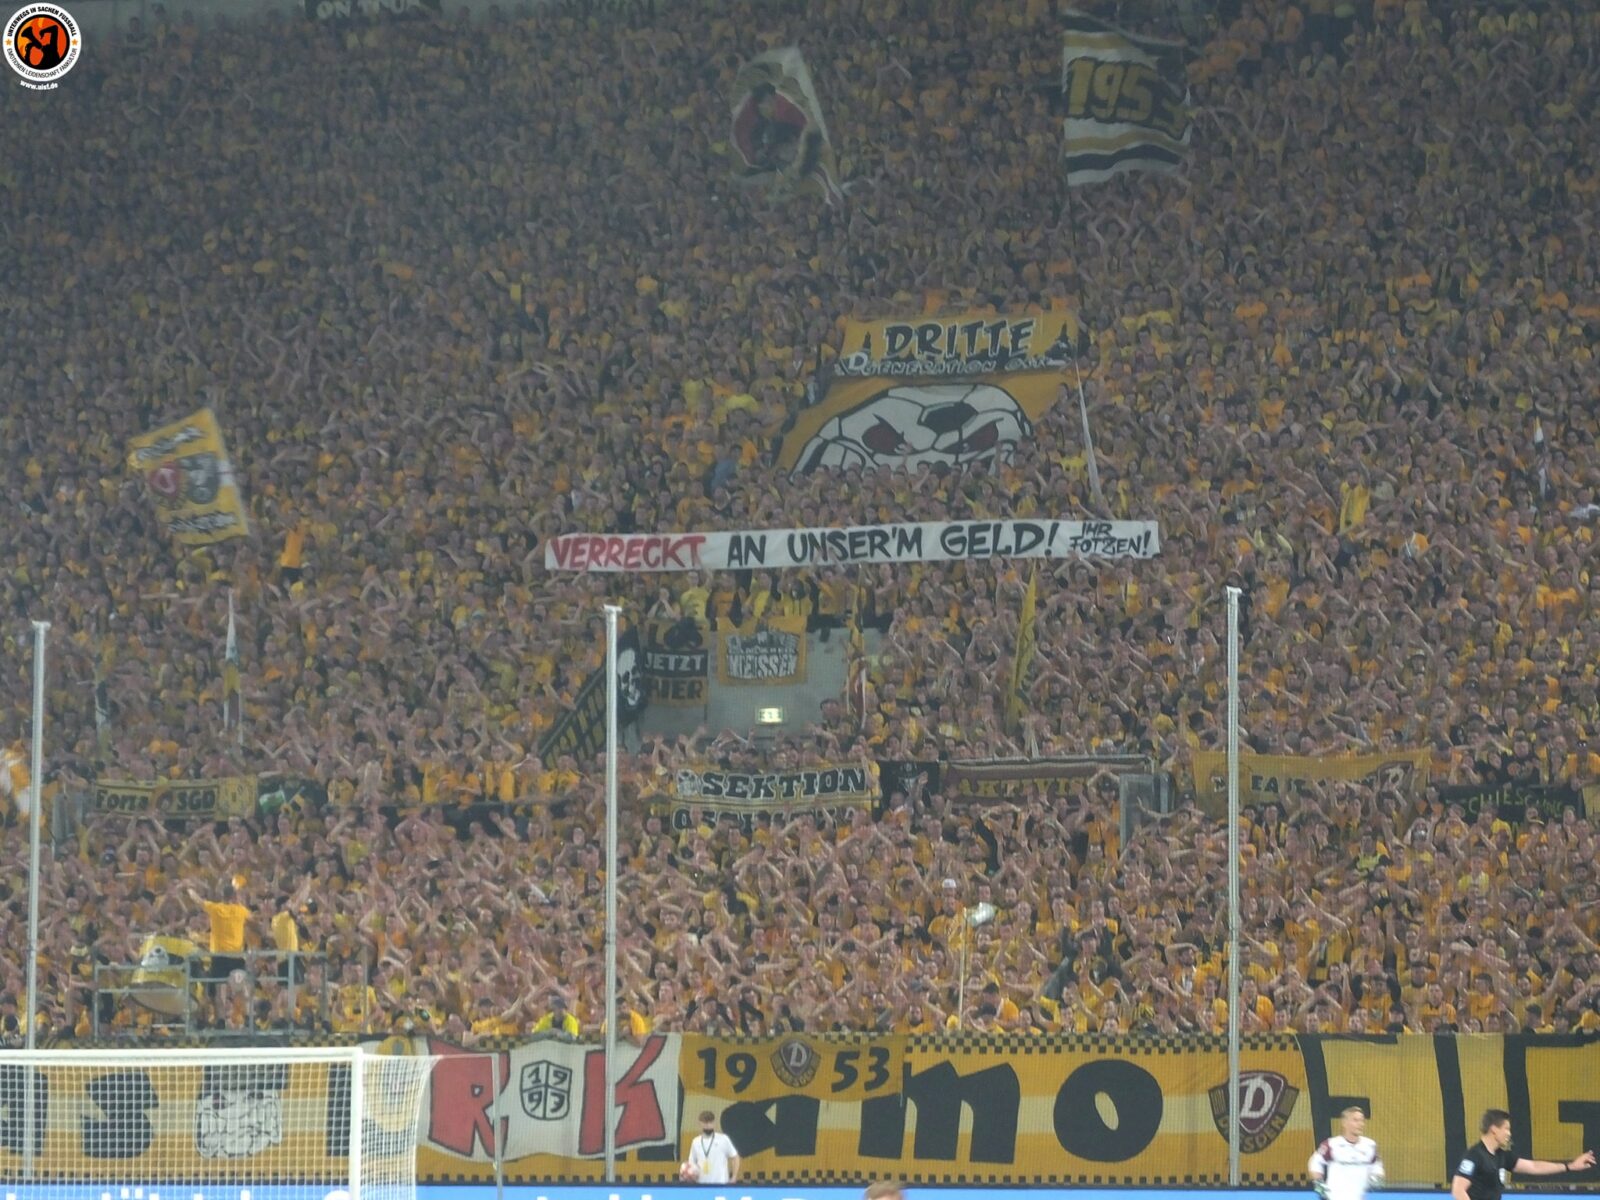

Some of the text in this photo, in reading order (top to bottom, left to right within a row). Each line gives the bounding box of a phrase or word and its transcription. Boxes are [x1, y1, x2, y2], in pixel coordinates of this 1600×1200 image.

[884, 317, 1036, 359] DRITTE
[551, 522, 1060, 570] VERRECKT AN UNSER'M GELD!
[1081, 521, 1114, 538] IHR
[645, 652, 706, 673] JETZT
[176, 788, 216, 811] SGD
[701, 767, 867, 799] SEKTION
[1251, 774, 1306, 792] EAT
[697, 1047, 891, 1094] 19 53
[578, 1034, 667, 1156] K
[1215, 1110, 1287, 1153] DSDEN
